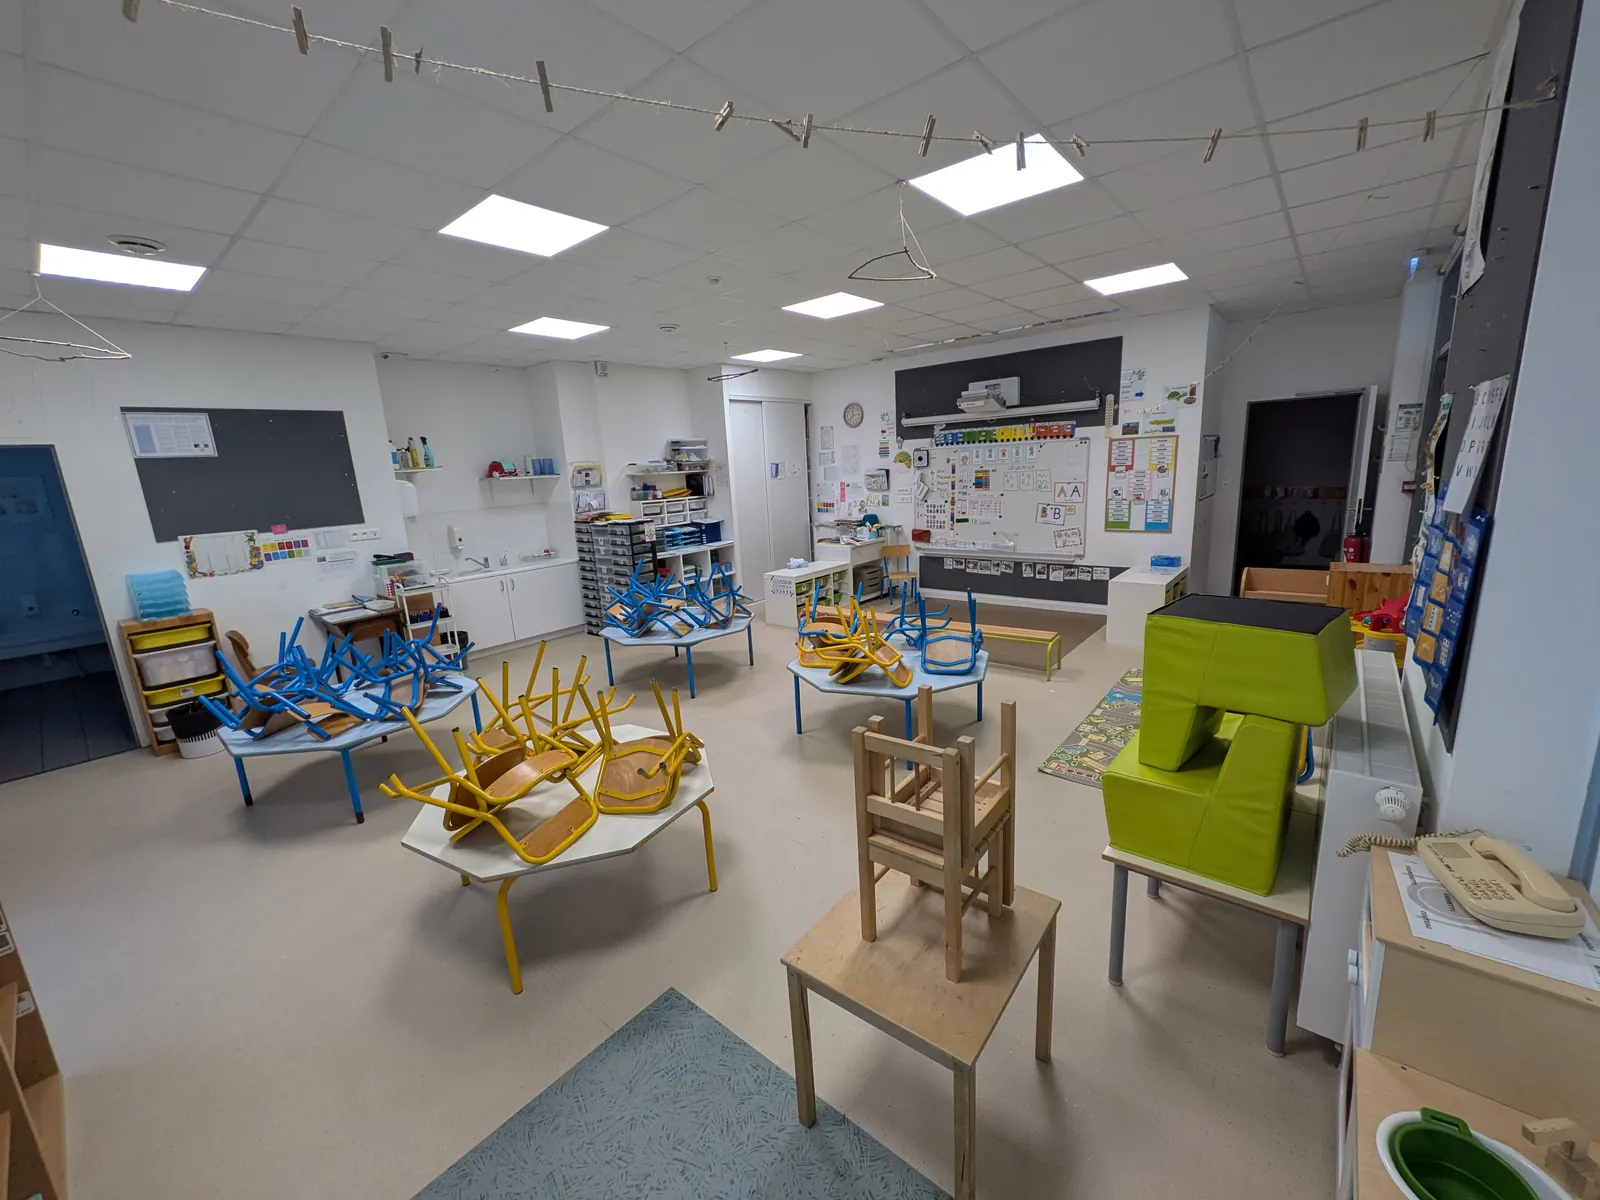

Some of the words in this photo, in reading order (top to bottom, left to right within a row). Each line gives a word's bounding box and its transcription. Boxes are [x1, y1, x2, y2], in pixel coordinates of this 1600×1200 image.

[1057, 485, 1067, 498] A
[1070, 485, 1081, 498] A
[1053, 507, 1061, 520] B
